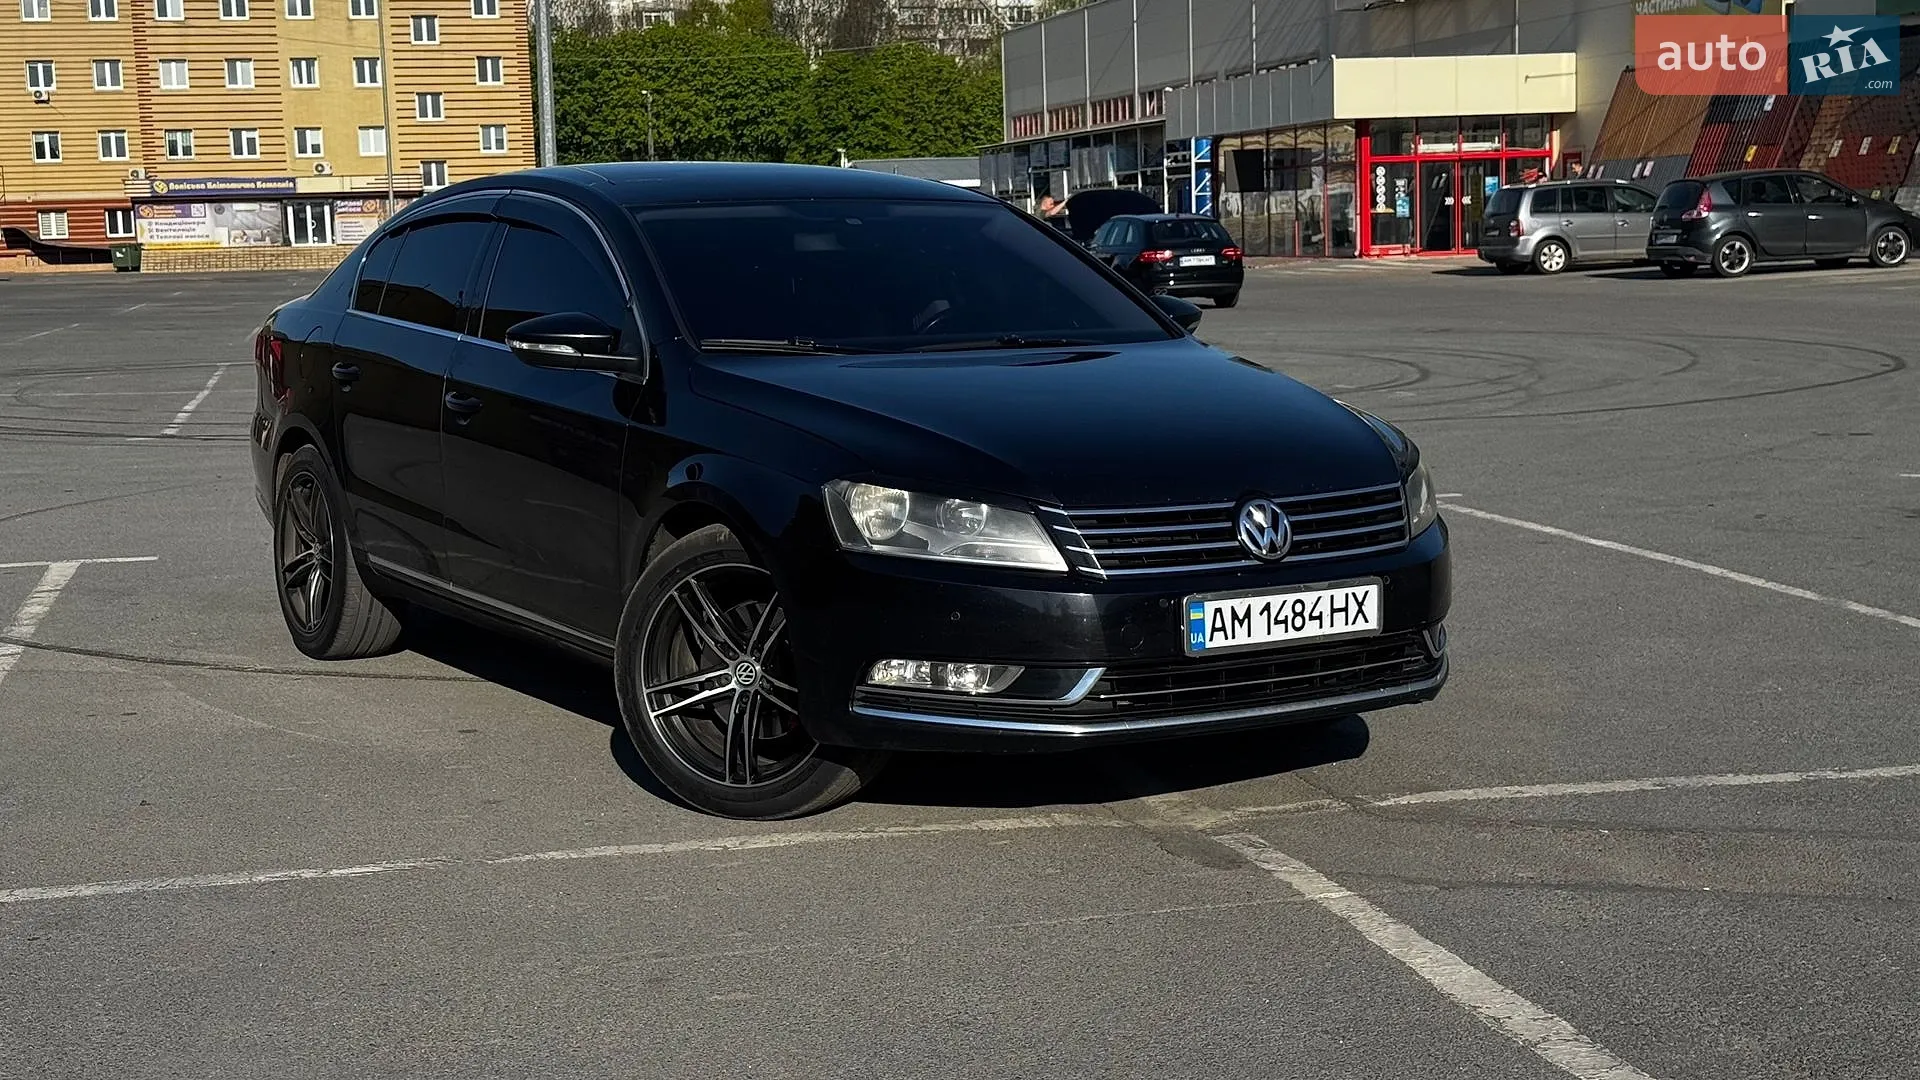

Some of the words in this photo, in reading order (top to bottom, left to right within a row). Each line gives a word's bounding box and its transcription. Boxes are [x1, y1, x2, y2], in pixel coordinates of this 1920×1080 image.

[1208, 603, 1251, 642] AM
[1258, 595, 1323, 636] 1484
[1329, 590, 1370, 628] HX
[1190, 632, 1204, 644] UA
